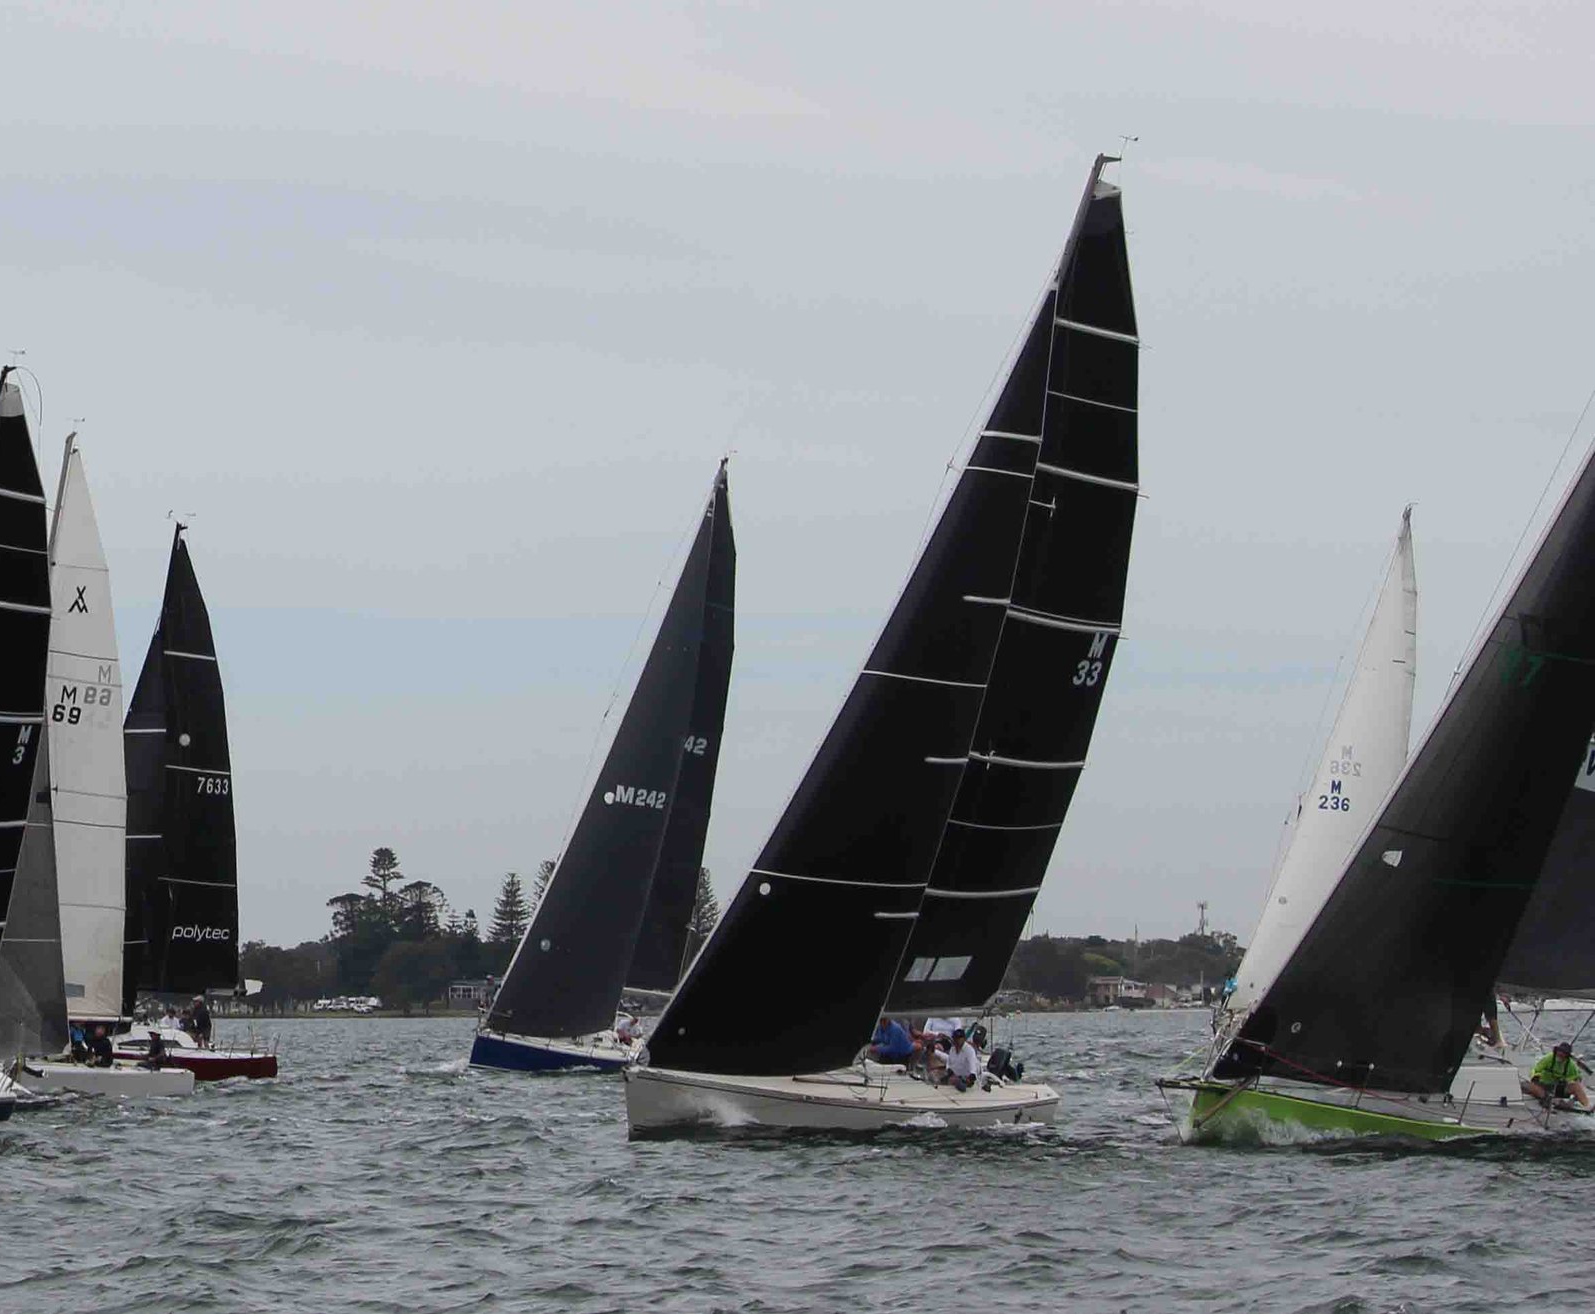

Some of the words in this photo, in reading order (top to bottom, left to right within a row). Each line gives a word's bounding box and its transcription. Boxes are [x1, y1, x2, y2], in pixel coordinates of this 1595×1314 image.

[1088, 632, 1108, 658] M
[1073, 660, 1102, 686] 33
[61, 685, 77, 704] M
[53, 704, 81, 725] 69
[17, 725, 32, 744] M
[12, 746, 25, 764] 3
[197, 777, 229, 795] 7633
[1331, 780, 1341, 794] M
[1319, 795, 1350, 812] 236
[172, 925, 230, 942] polytec
